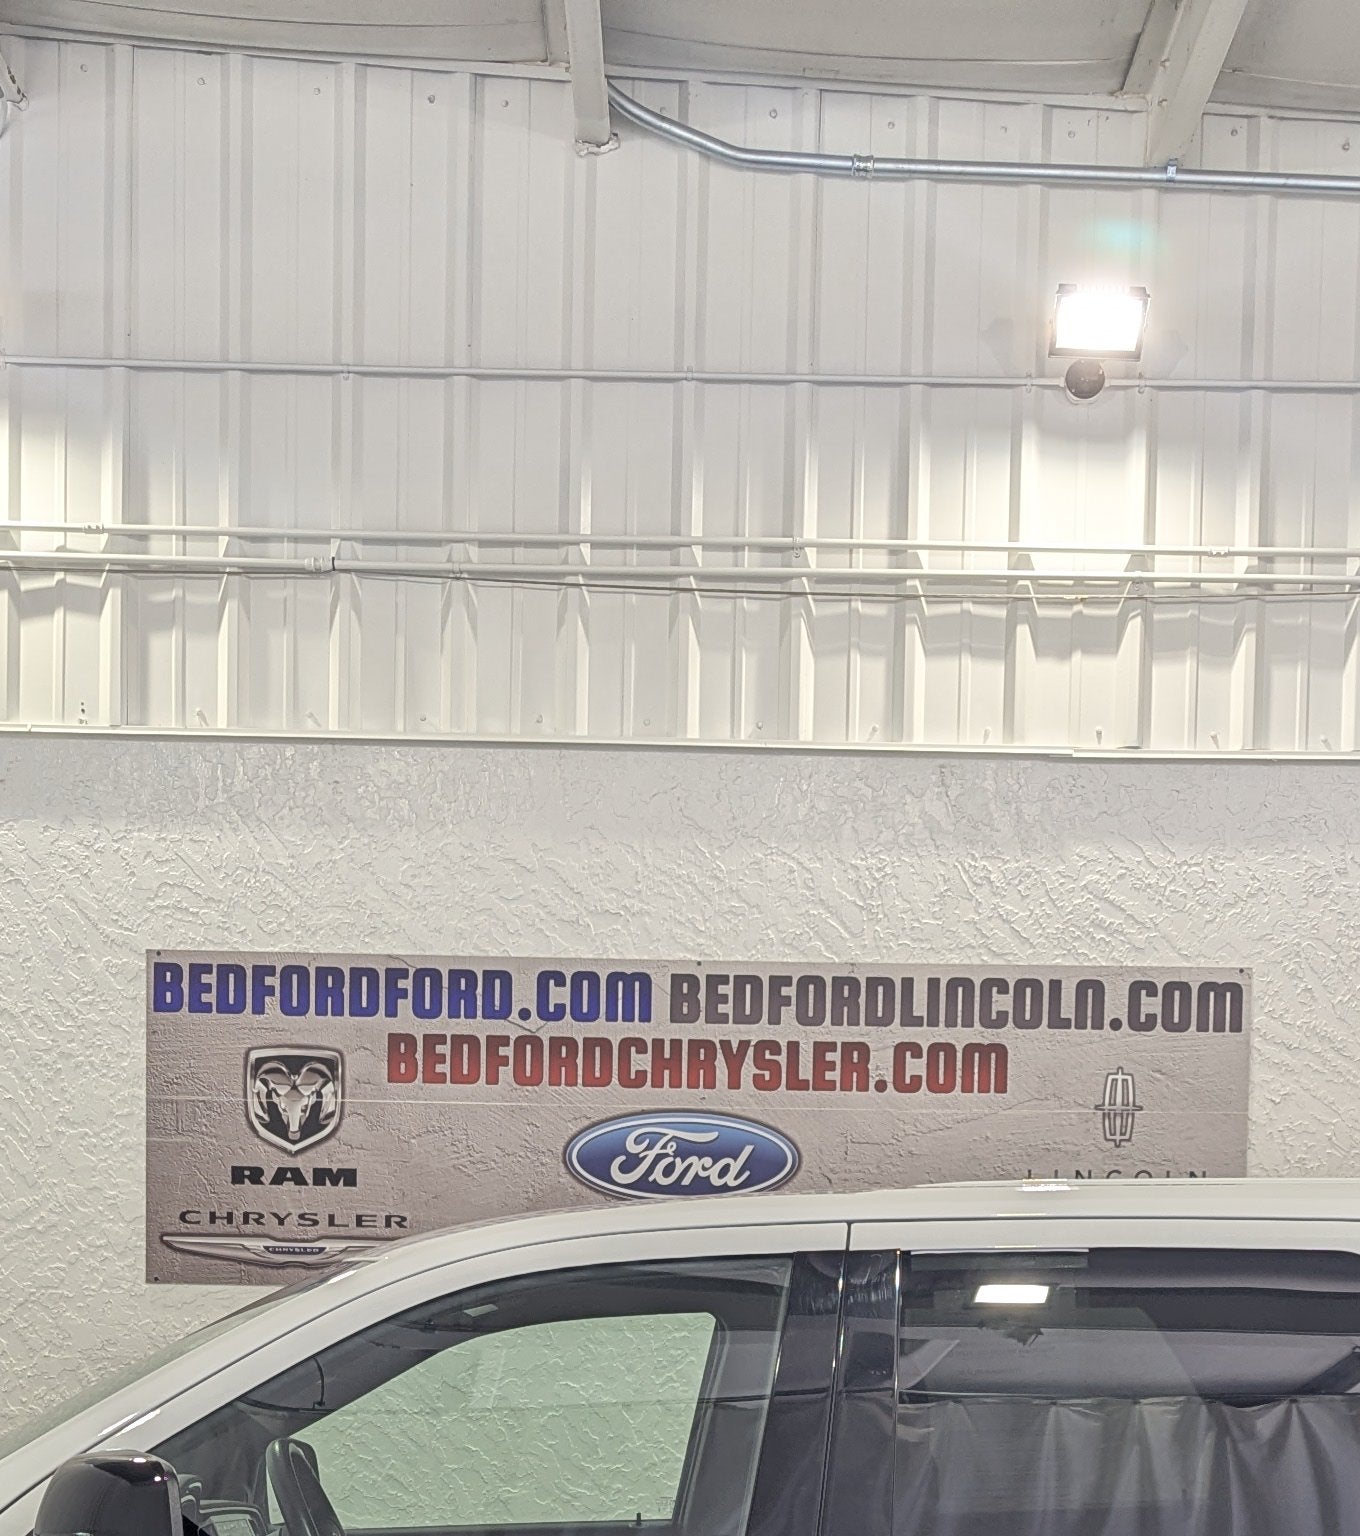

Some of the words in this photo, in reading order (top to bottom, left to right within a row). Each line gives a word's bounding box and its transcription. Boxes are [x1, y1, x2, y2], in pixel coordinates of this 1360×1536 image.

[152, 961, 653, 1024] BEDFORDFORD.COM
[669, 972, 1244, 1034] BEDFORDLINCOLN.COM
[386, 1032, 1009, 1095] BEDFORDCHRYSLER.COM
[230, 1165, 358, 1188] RAM
[609, 1126, 755, 1188] Ford
[178, 1209, 409, 1229] CHRYSLER
